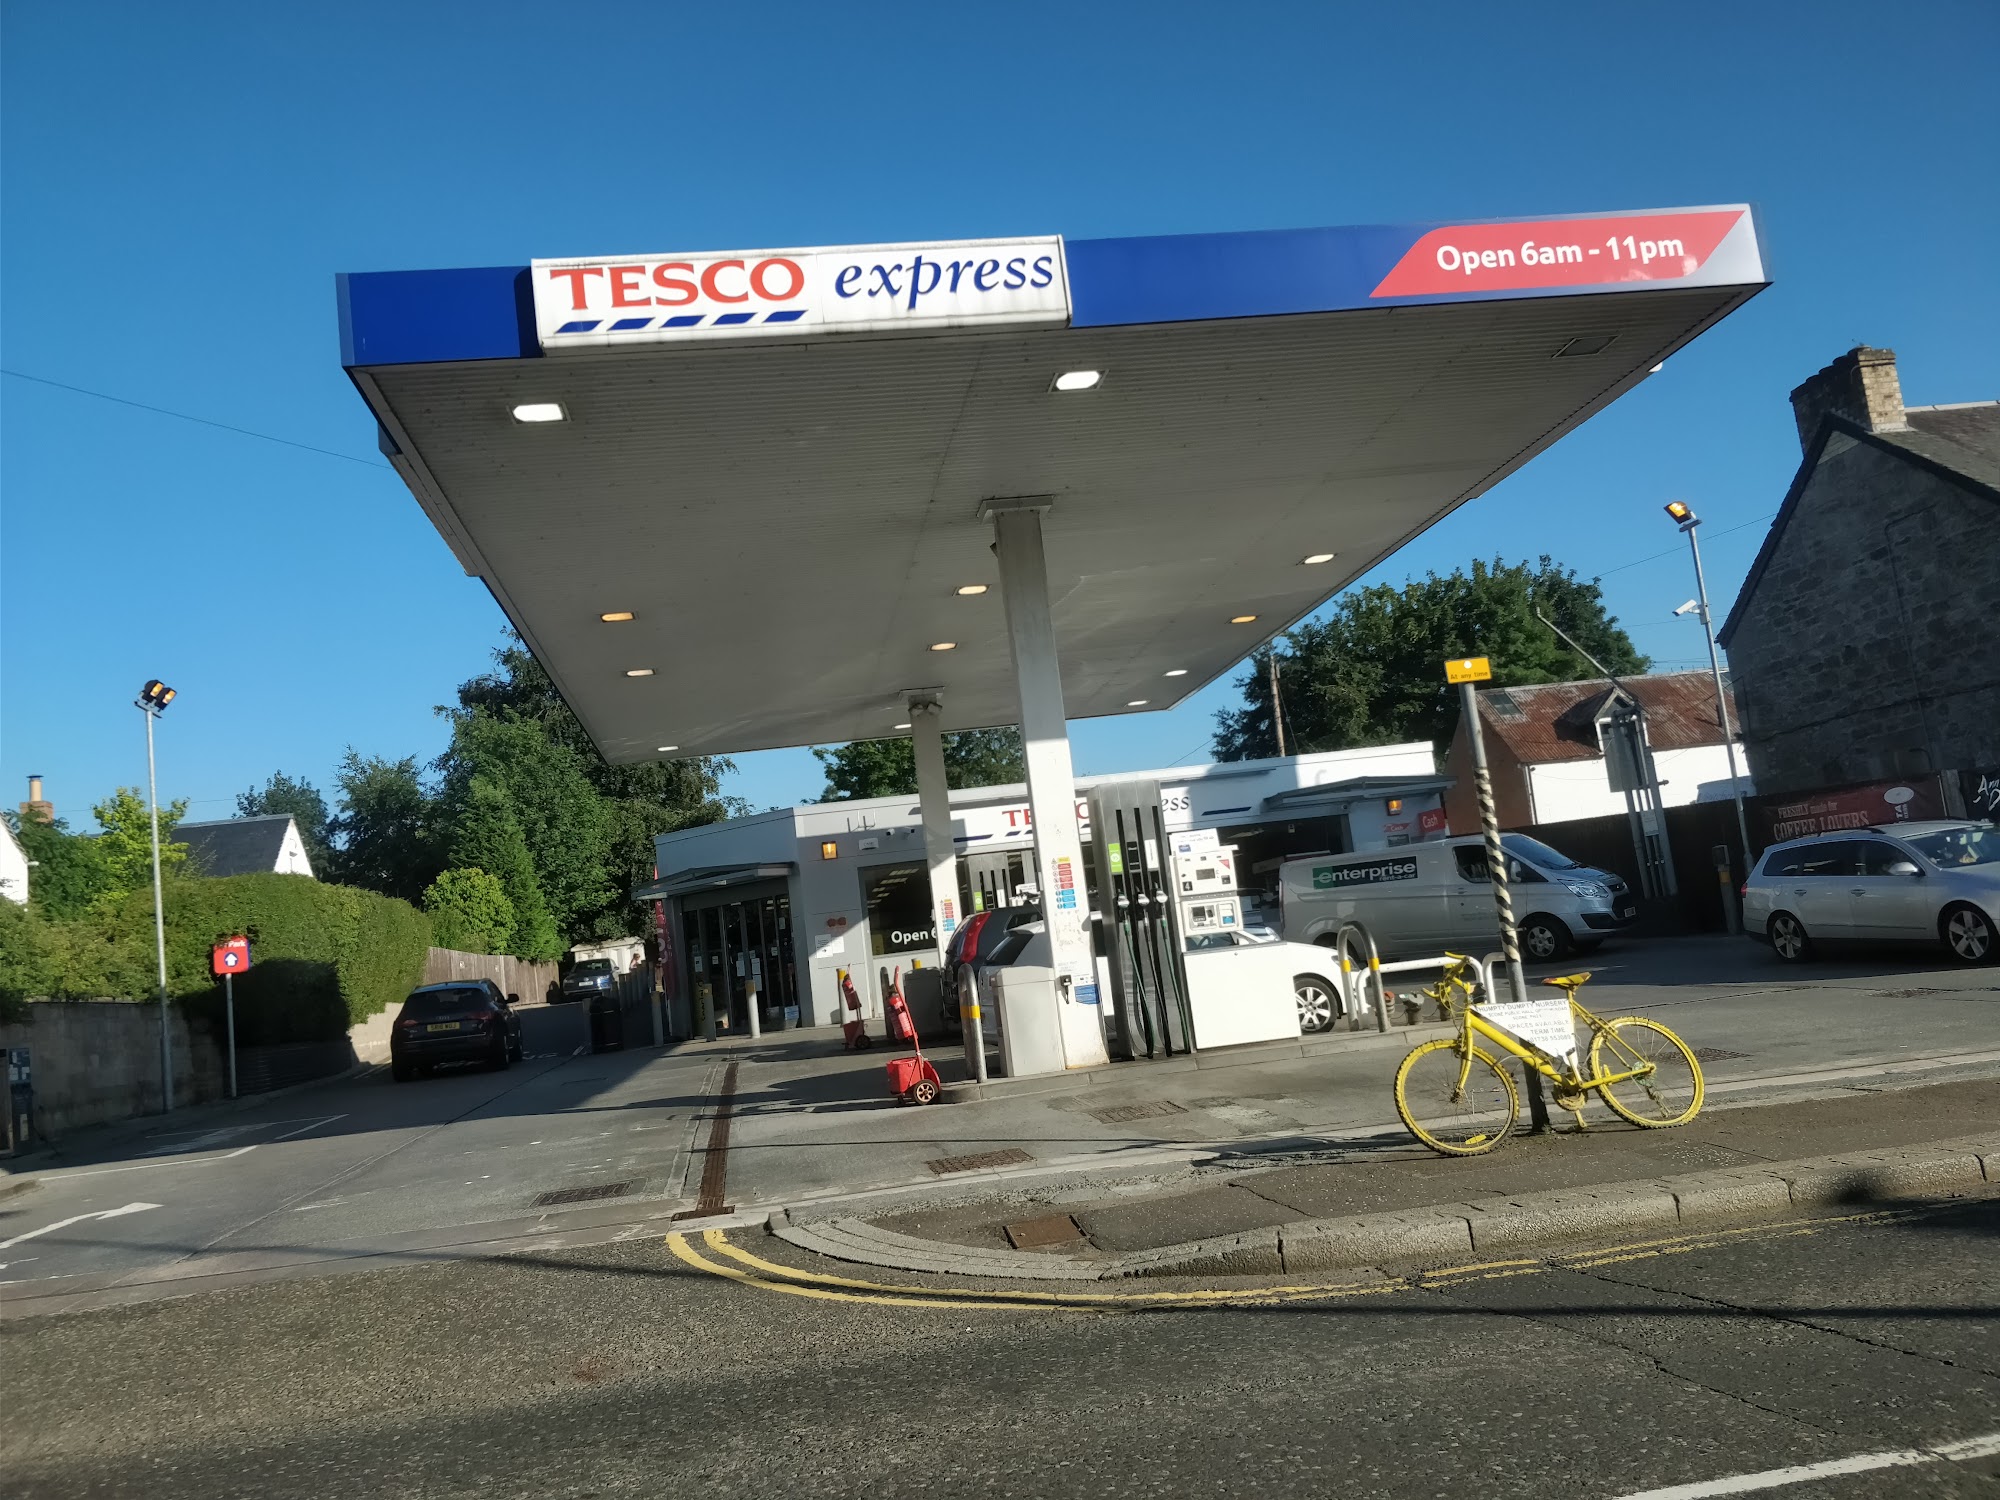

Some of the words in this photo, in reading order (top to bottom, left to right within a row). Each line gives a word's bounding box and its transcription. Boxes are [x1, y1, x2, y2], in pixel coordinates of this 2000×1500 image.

[1436, 245, 1516, 276] Open
[1520, 241, 1583, 267] 6am
[1605, 235, 1685, 265] 11pm
[549, 258, 805, 311] TESCO
[834, 254, 1054, 311] express
[1778, 803, 1809, 818] FRESHLY
[1422, 813, 1438, 828] Cash
[1773, 818, 1816, 841] COFFEE
[1819, 811, 1870, 831] LOVERS
[1315, 862, 1416, 884] enterprise
[1379, 873, 1416, 881] rent-a-car
[891, 930, 929, 945] Open
[1507, 1002, 1534, 1010] DUMPTY
[1535, 1000, 1567, 1008] NURSERY
